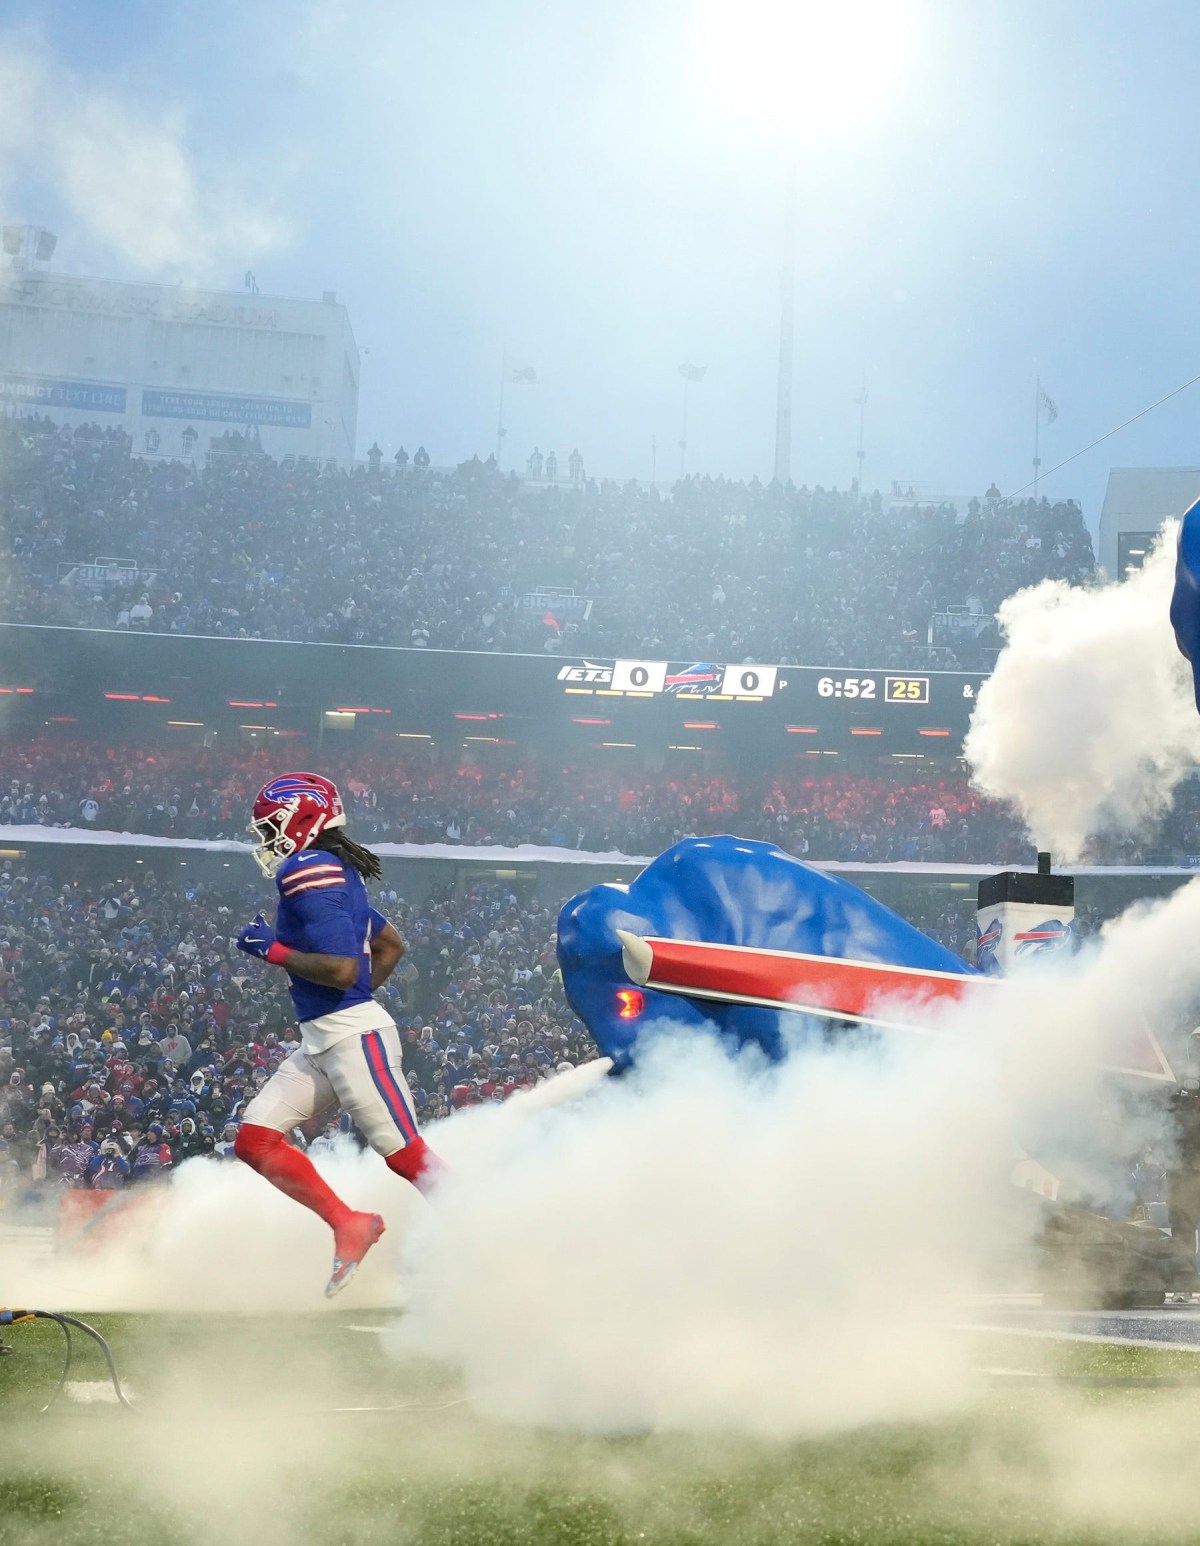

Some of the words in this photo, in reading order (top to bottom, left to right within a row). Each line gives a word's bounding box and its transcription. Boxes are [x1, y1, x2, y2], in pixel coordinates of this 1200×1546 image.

[56, 388, 88, 402] TEXT
[91, 391, 120, 406] LINE
[557, 660, 612, 683] JETS
[630, 667, 649, 687] 0
[740, 671, 760, 692] 0
[817, 677, 876, 699] 6:52
[892, 681, 921, 699] 25
